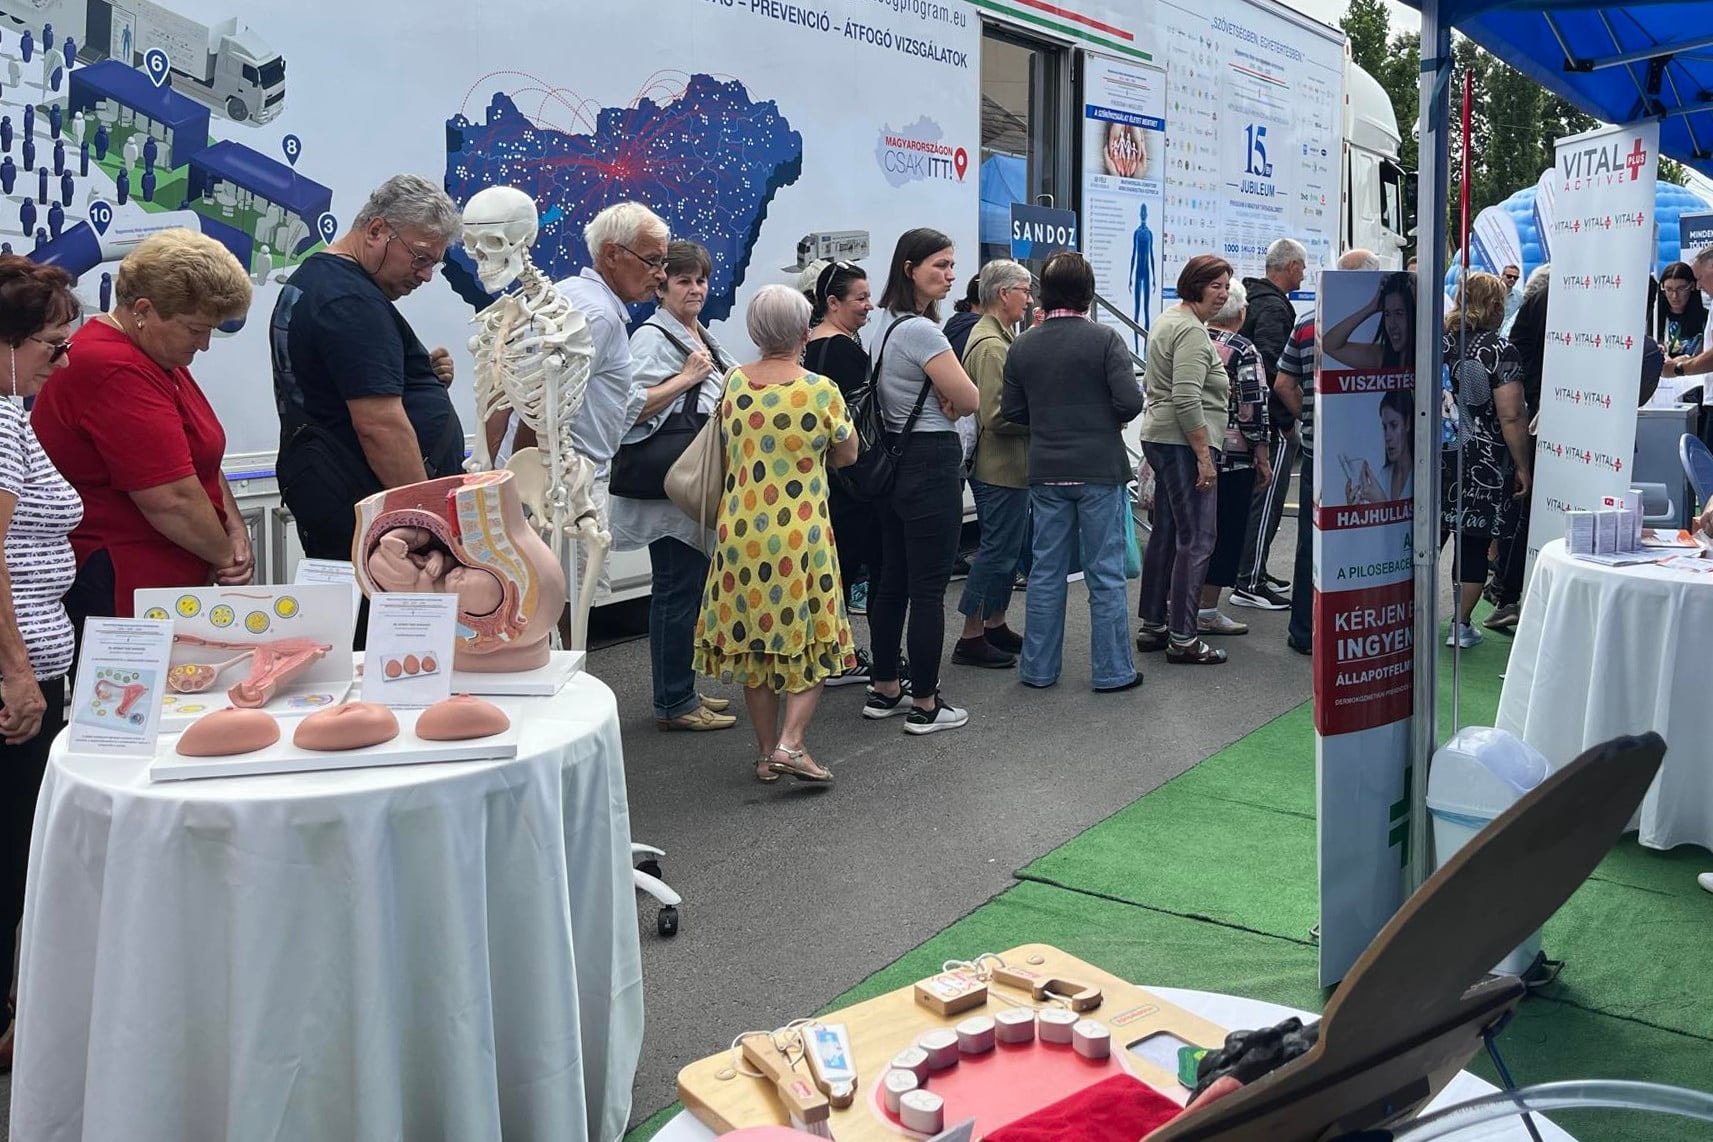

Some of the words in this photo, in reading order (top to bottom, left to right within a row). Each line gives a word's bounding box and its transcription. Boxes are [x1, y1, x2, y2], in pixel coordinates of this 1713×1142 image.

[751, 0, 830, 32] PREVENCIÓ
[844, 17, 892, 48] ÁTFOGÓ
[895, 34, 967, 68] VIZSGÁLATOK
[151, 55, 163, 71] 6
[286, 139, 297, 154] 8
[885, 136, 953, 156] MAGYARORSZÁGON
[1244, 123, 1267, 176] 15
[884, 150, 925, 176] CSAK
[927, 158, 953, 180] ITT!
[1563, 144, 1625, 180] VITAL
[1627, 154, 1645, 166] PLUS
[1240, 179, 1275, 197] JUBILEUM
[1564, 172, 1625, 192] ACTIVE
[90, 208, 109, 223] 10
[1584, 217, 1604, 227] VITAL
[1615, 212, 1636, 224] VITAL
[323, 219, 334, 233] 3
[1013, 220, 1076, 246] SANDOZ
[1563, 276, 1584, 285] VITAL
[1593, 275, 1615, 285] VITAL
[1574, 332, 1594, 343] VITAL
[1604, 334, 1624, 345] VITAL
[1555, 387, 1575, 399] VITAL
[1583, 391, 1605, 403] VITAL
[1565, 445, 1584, 459] VITAL
[1594, 452, 1614, 467] VITAL
[1528, 546, 1539, 558] VIT
[1337, 567, 1346, 580] A
[1335, 603, 1405, 632] KÉRJEN
[1337, 626, 1413, 661] INGYEN
